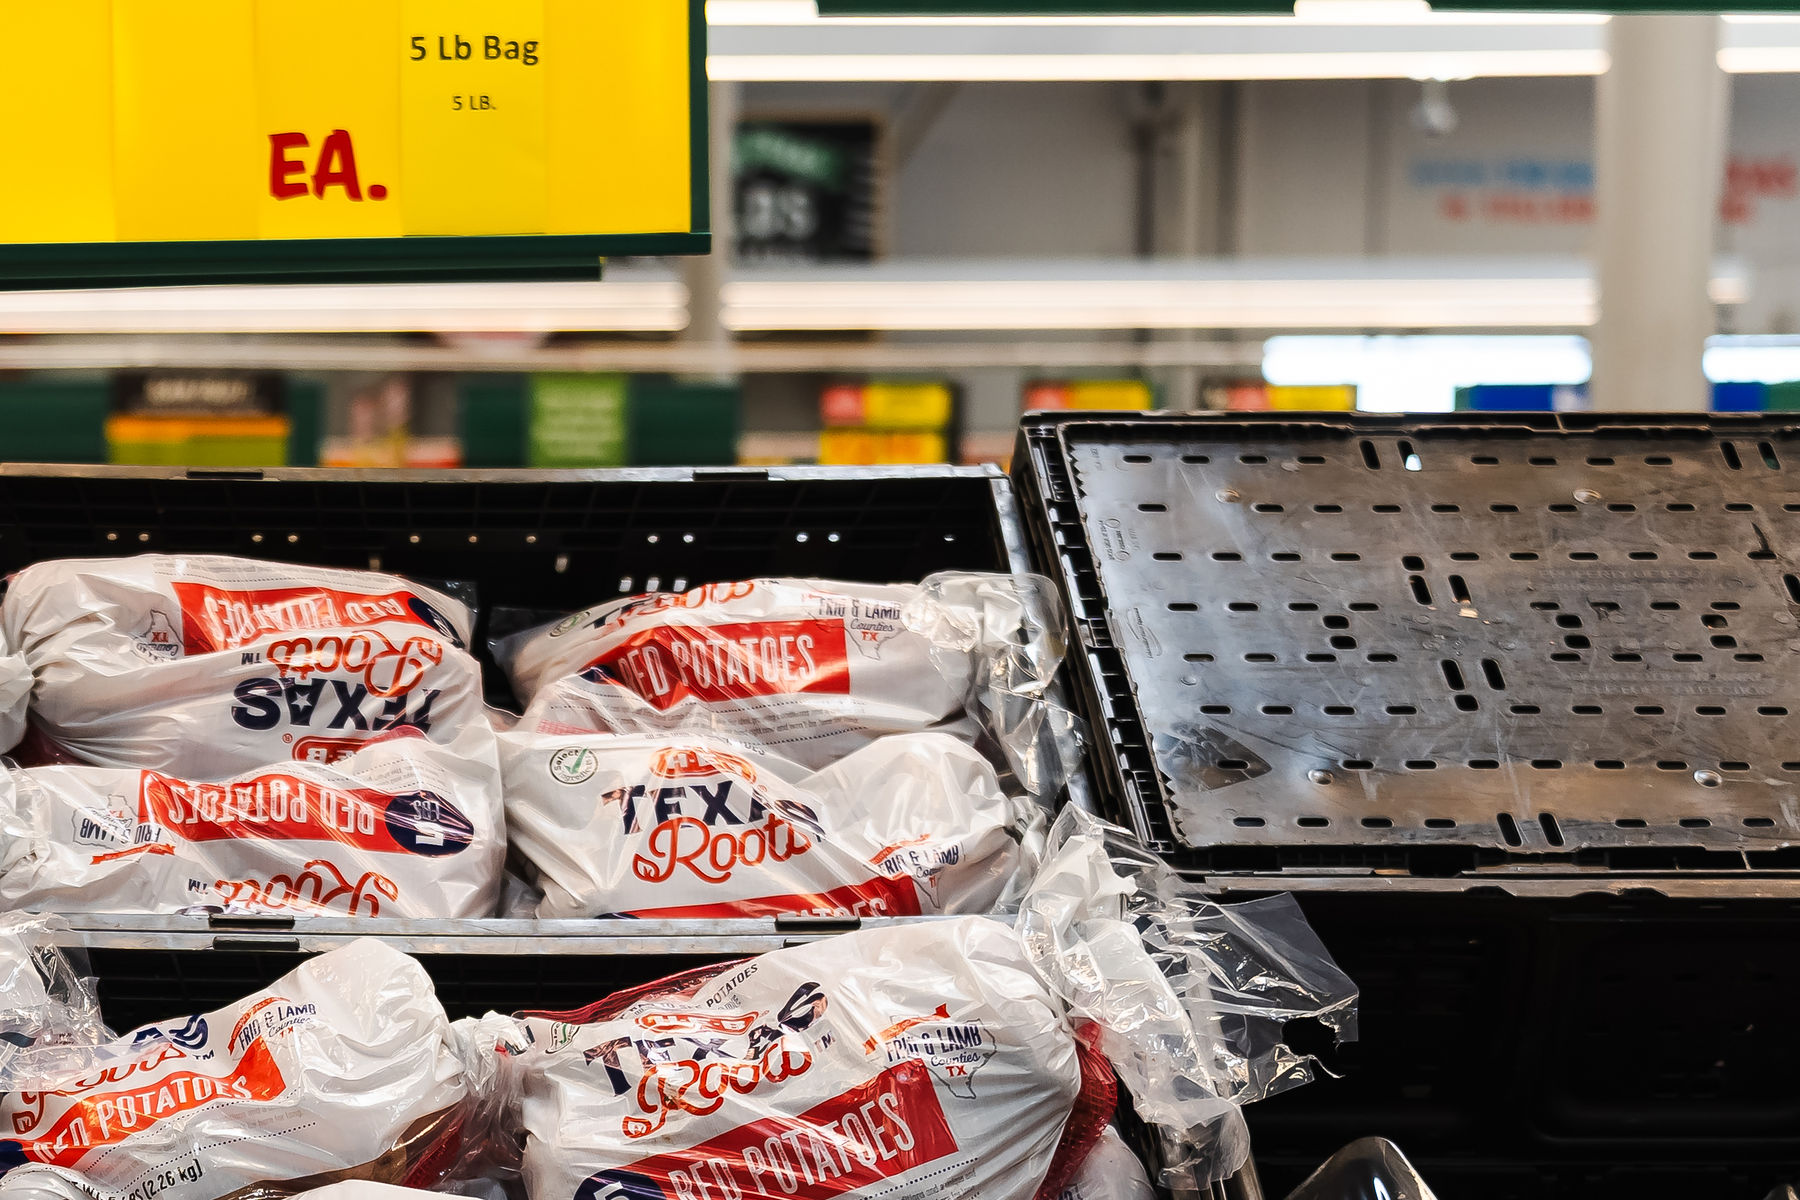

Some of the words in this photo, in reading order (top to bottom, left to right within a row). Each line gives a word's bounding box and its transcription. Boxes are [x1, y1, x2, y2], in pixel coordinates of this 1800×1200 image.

[410, 36, 426, 60] 5
[438, 36, 471, 61] Lb
[483, 36, 540, 66] Bag
[452, 96, 462, 111] 5
[469, 96, 496, 111] LB.
[269, 129, 388, 201] EA.
[620, 645, 671, 703] RED
[673, 634, 816, 686] POTATOES
[231, 677, 442, 733] TEXAS
[169, 776, 307, 825] POTATOES
[322, 797, 376, 834] RED
[415, 821, 445, 846] 5
[631, 813, 813, 884] Roots
[237, 1024, 263, 1054] FRIO
[277, 1002, 317, 1024] LAMB
[939, 1024, 982, 1051] LAMB
[930, 1049, 981, 1068] Counties
[945, 1064, 967, 1077] TX
[99, 1075, 254, 1140] POTATOES
[622, 1049, 814, 1139] Roots
[749, 1091, 917, 1200] POTATOES
[177, 1158, 205, 1187] kg)
